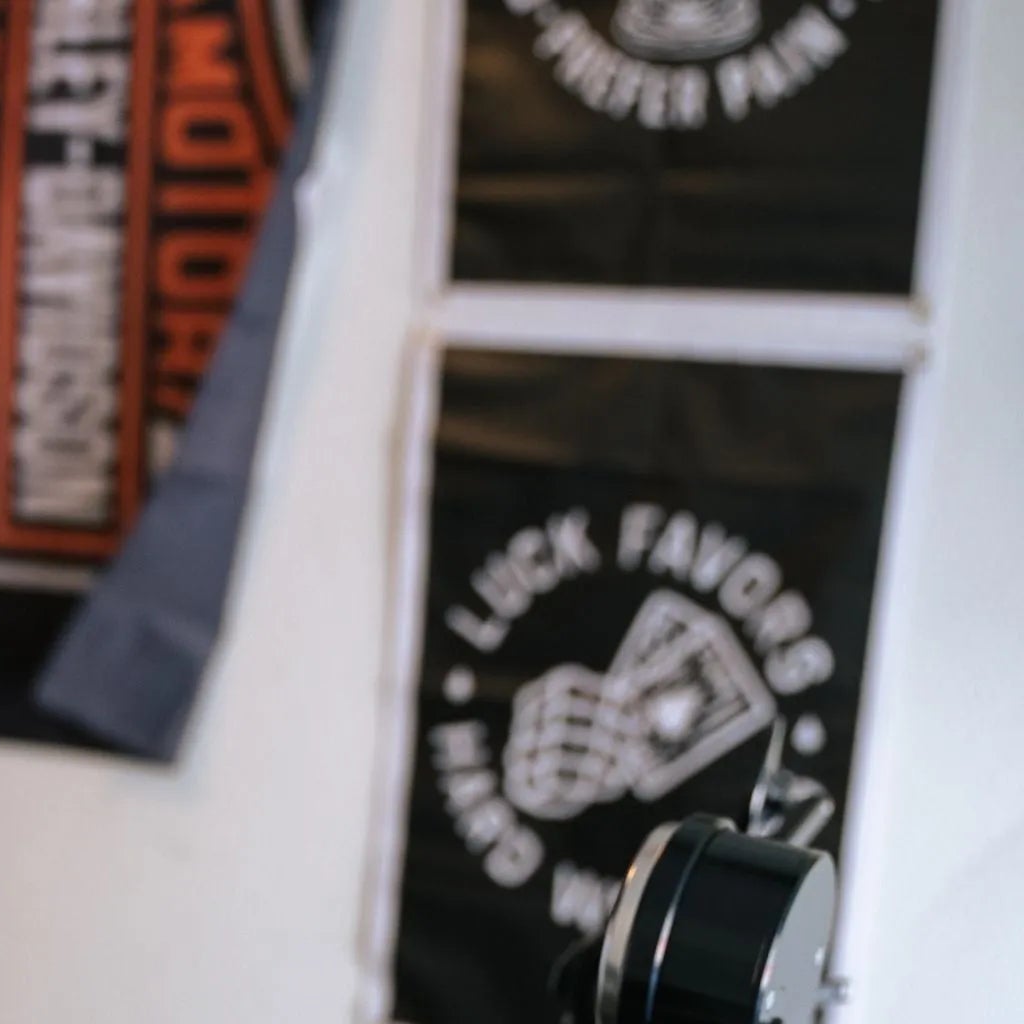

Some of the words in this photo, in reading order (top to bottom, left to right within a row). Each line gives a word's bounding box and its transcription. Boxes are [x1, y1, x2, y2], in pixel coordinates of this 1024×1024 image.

[445, 507, 602, 653] LUCK
[616, 502, 835, 696] FAVORS
[429, 719, 545, 889] HARD
